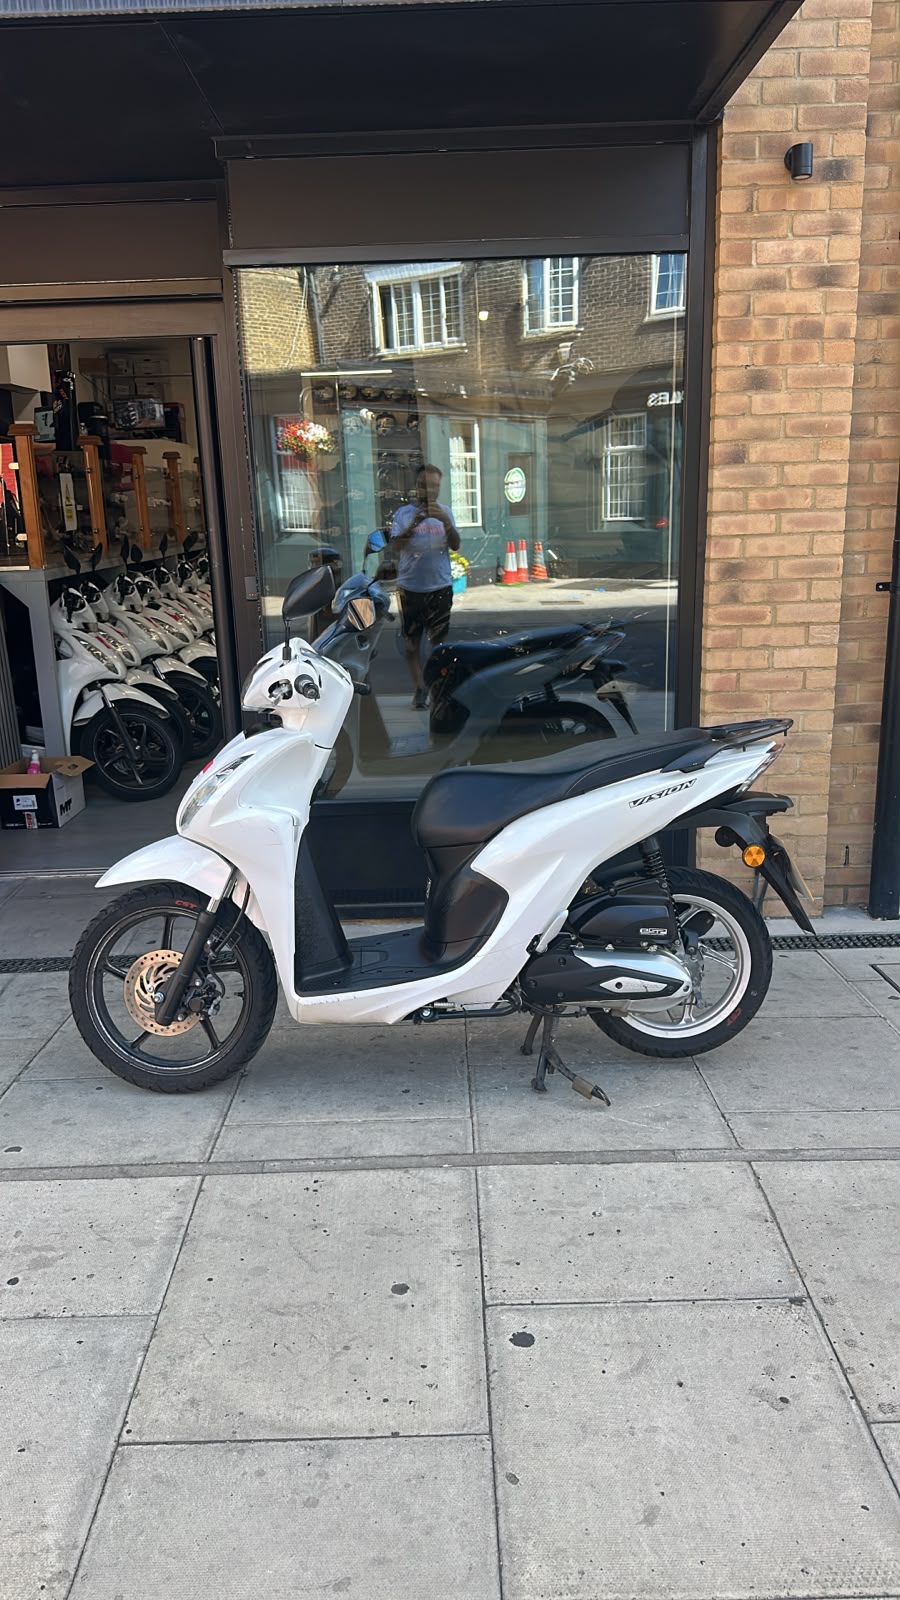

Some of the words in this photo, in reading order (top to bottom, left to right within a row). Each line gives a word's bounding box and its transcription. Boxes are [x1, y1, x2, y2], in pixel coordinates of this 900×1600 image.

[628, 778, 697, 808] VISION
[59, 798, 72, 816] MT
[175, 900, 198, 909] CST
